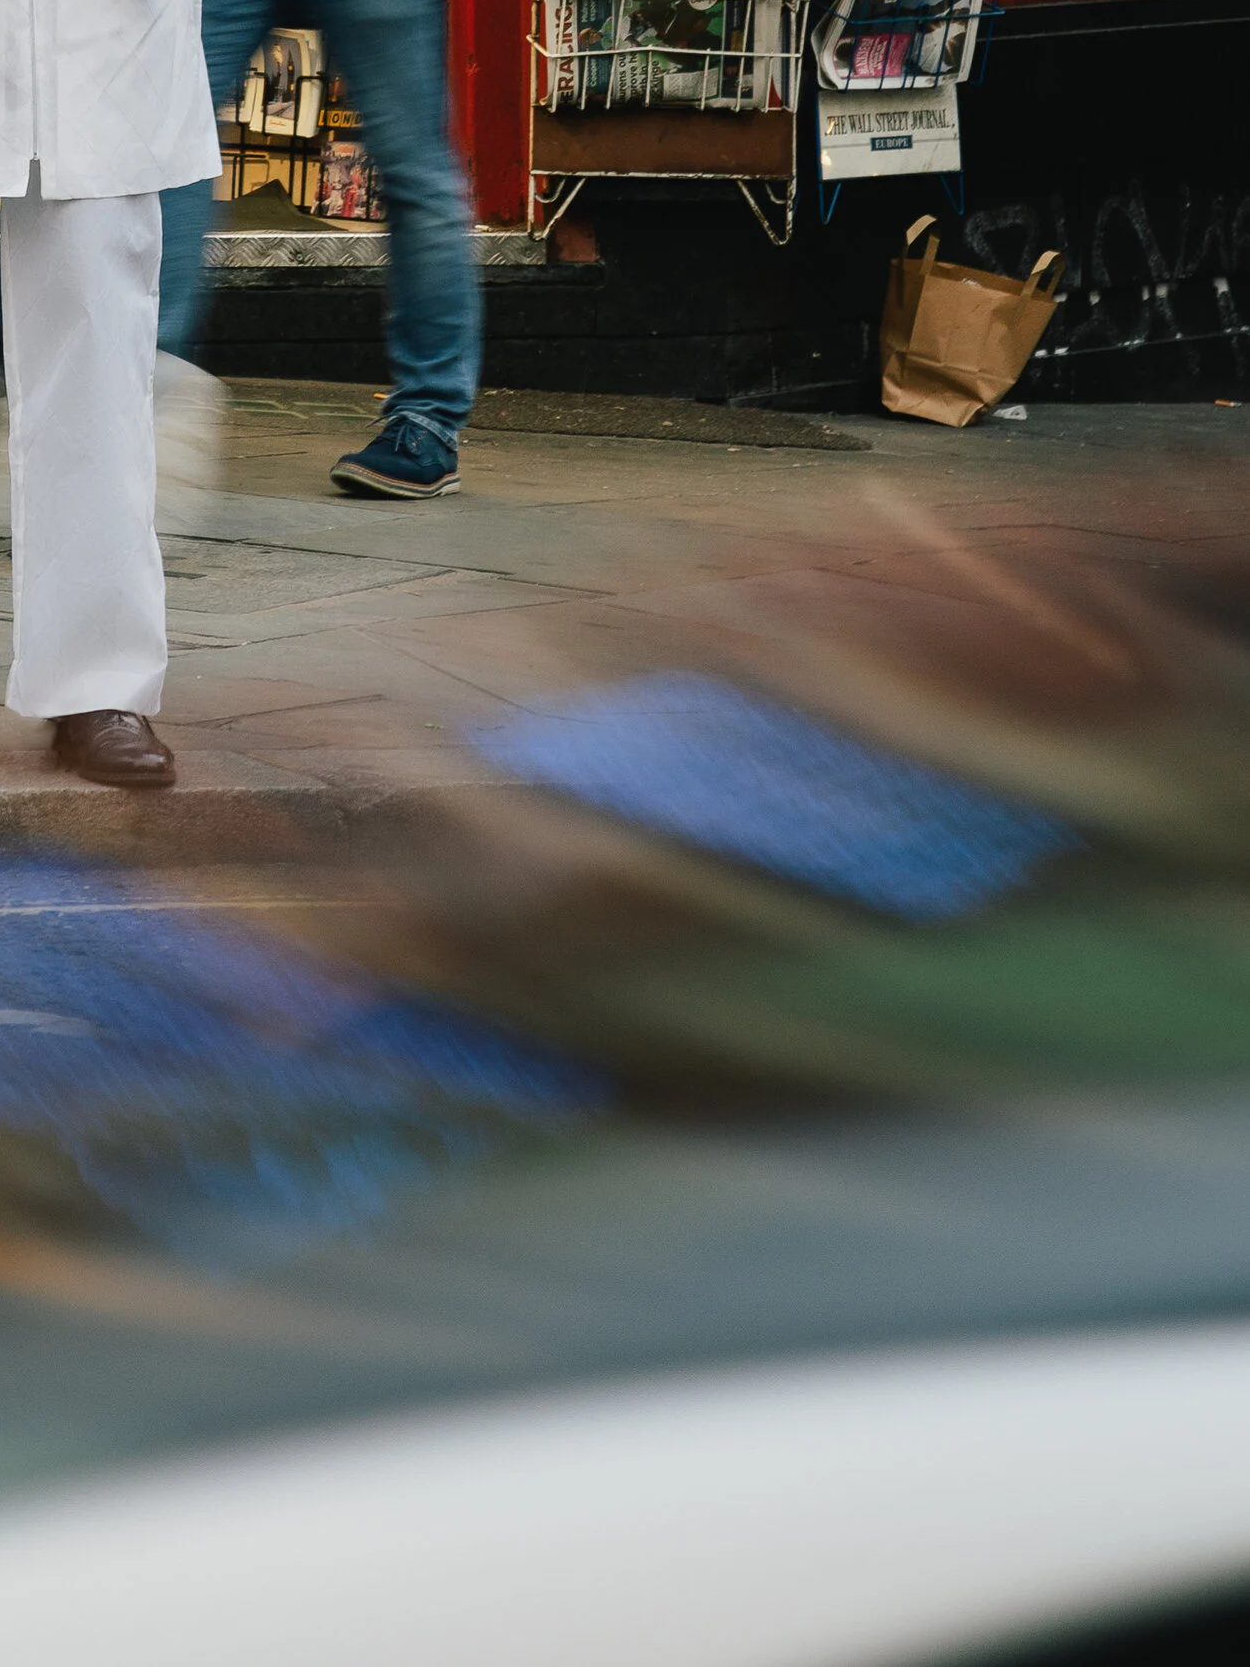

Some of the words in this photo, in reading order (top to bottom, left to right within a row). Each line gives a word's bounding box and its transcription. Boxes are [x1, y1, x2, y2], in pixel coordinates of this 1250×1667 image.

[848, 113, 875, 134] WALL
[875, 111, 911, 131] STREET
[874, 137, 910, 149] EUROPE
